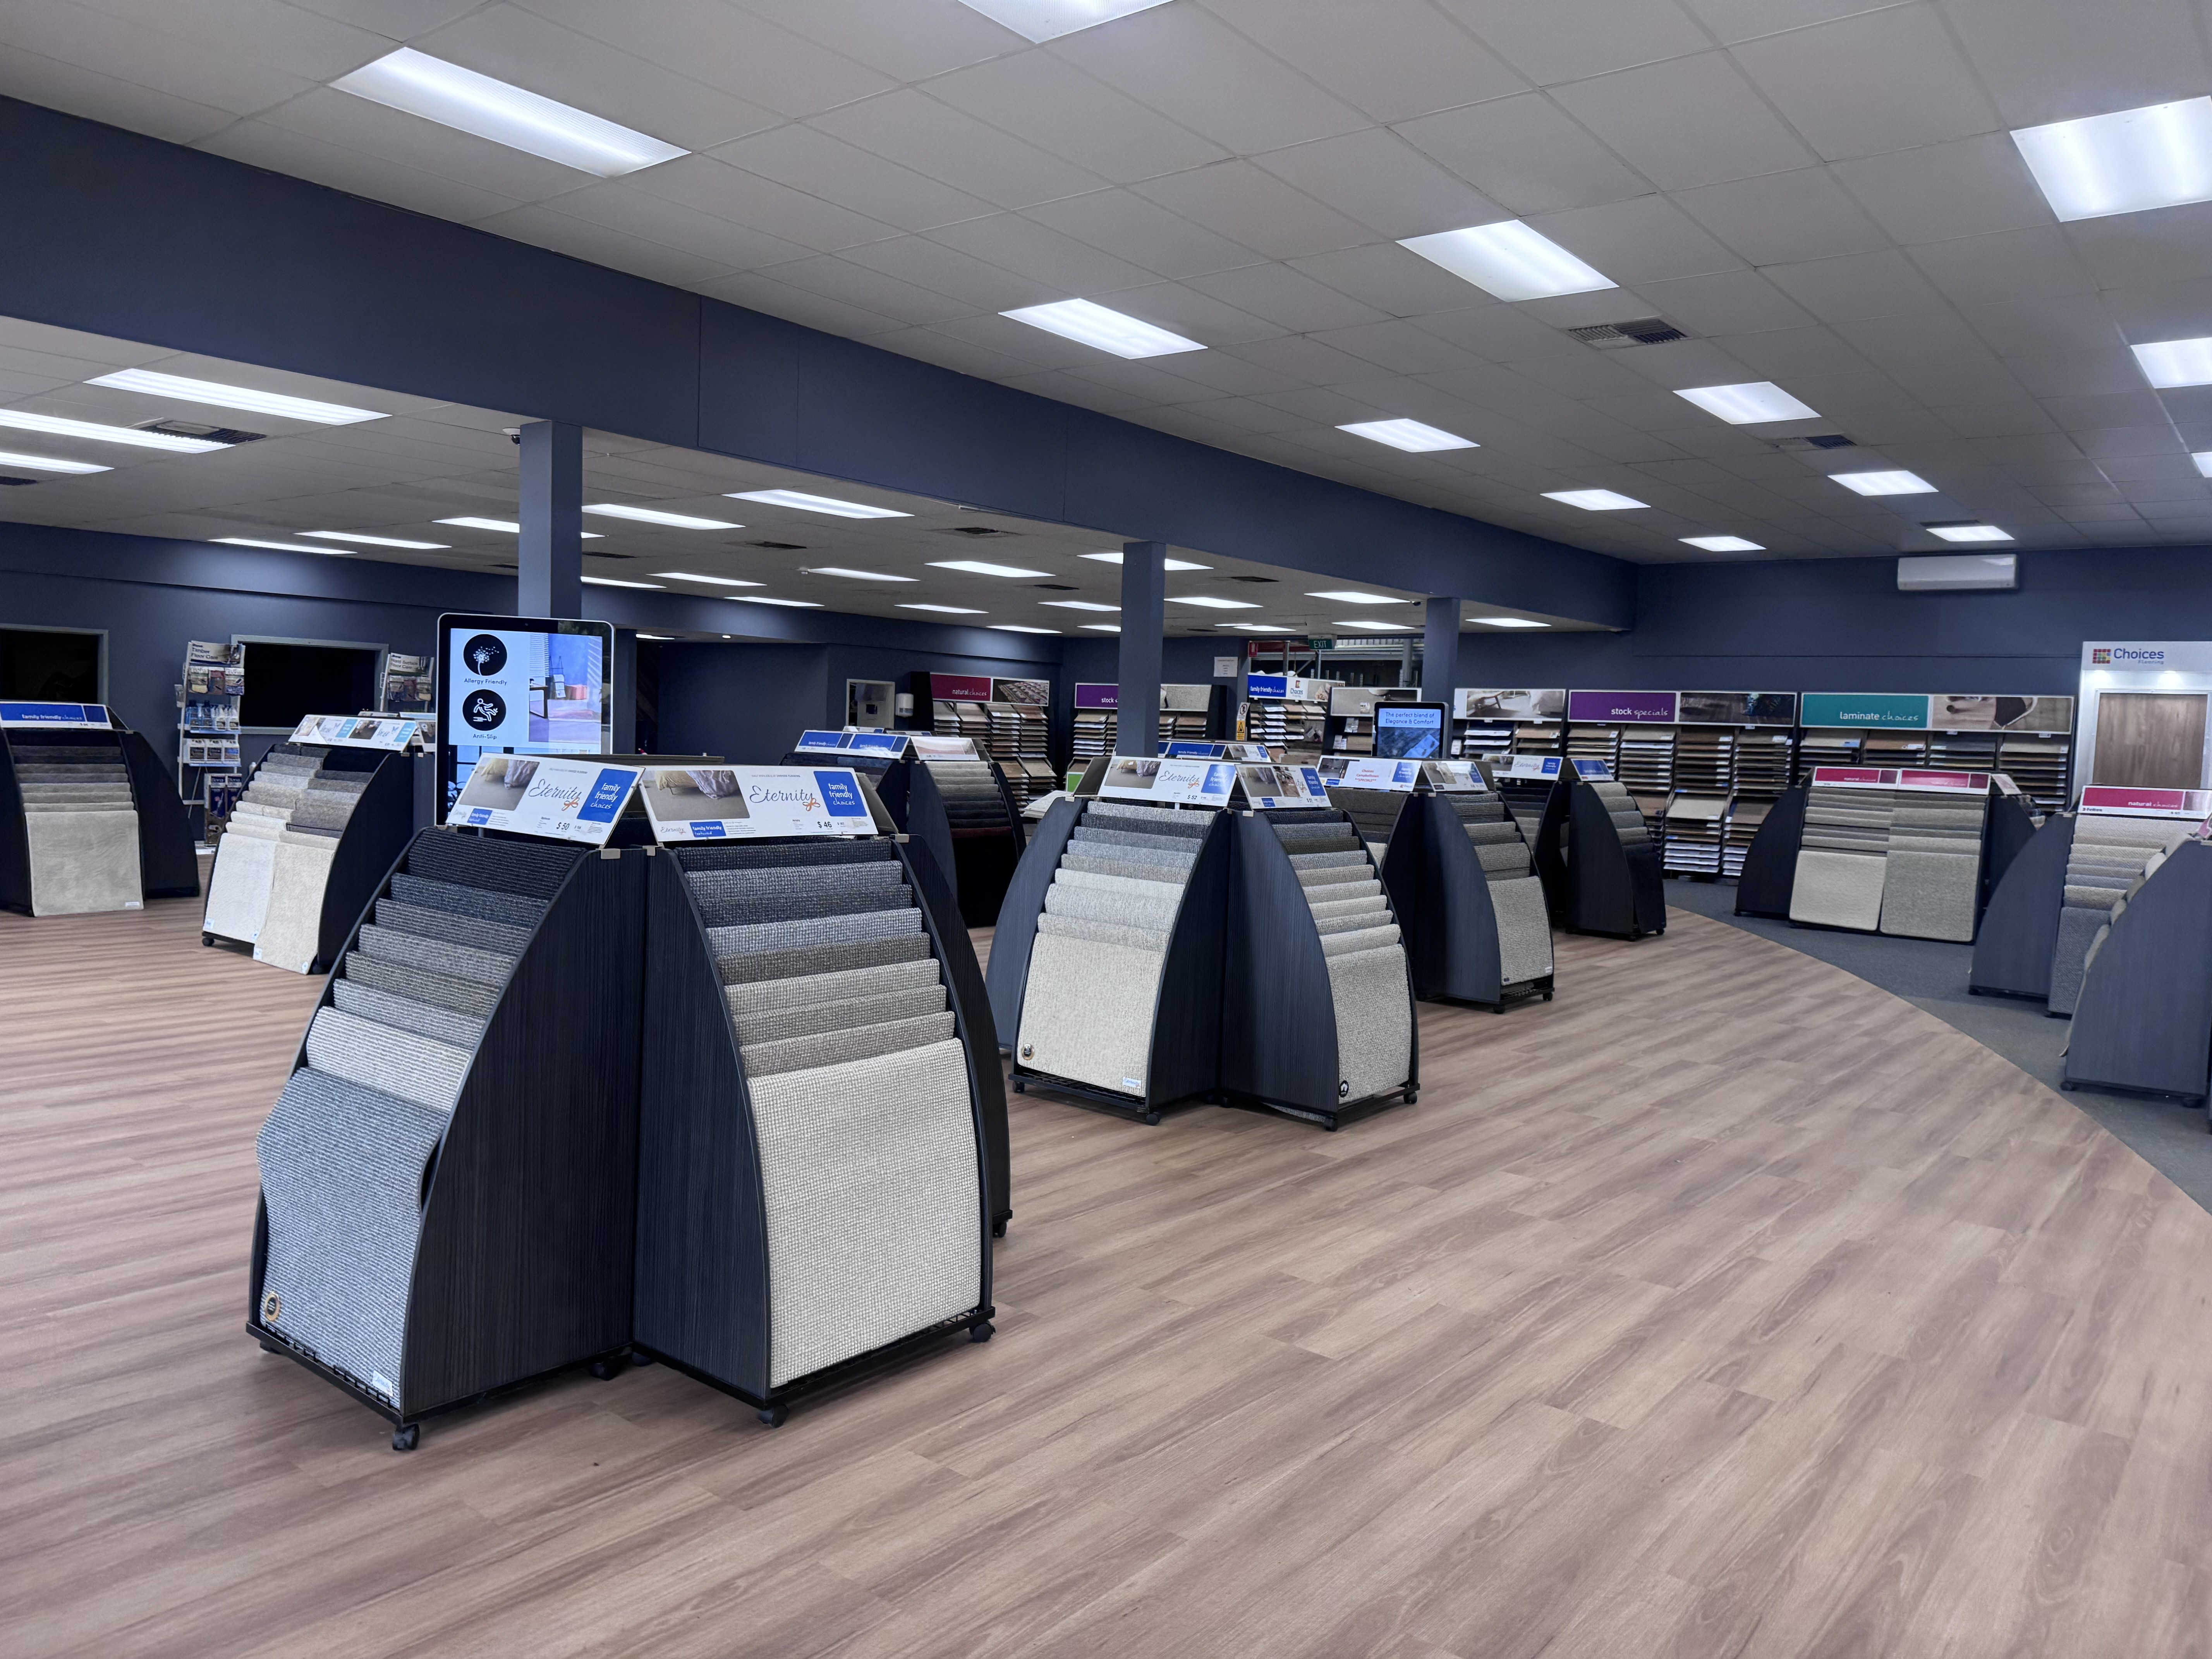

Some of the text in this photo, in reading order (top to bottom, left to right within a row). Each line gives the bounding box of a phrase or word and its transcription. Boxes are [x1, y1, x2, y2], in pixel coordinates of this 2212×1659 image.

[2114, 648, 2164, 659] Choices
[969, 688, 987, 696] choices
[1634, 707, 1668, 719] specials
[1840, 711, 1919, 721] laminate choices
[1159, 771, 1200, 782] Eternity
[529, 779, 582, 800] Eternity
[601, 783, 621, 793] family
[828, 783, 848, 792] family
[595, 791, 618, 802] friendly
[749, 785, 814, 803] Eternity
[829, 791, 853, 799] friendly
[590, 799, 612, 809] choices
